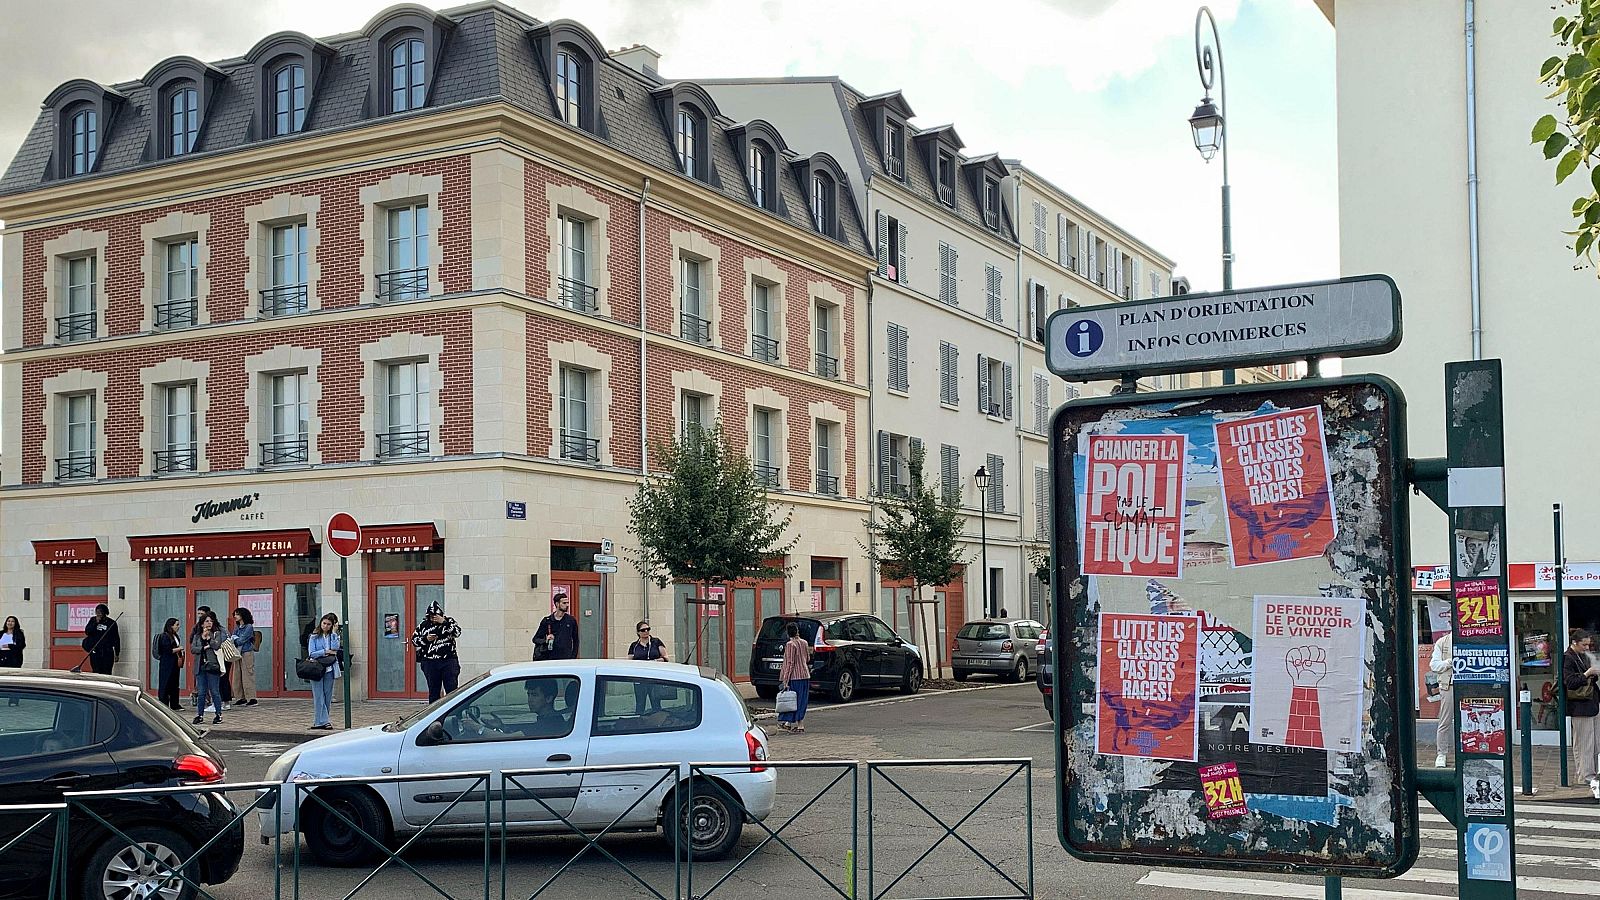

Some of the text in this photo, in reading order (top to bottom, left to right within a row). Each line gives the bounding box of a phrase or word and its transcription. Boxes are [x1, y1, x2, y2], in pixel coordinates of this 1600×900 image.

[1119, 294, 1315, 326] PLAN D'ORIENTATION
[1128, 322, 1306, 351] INFOS COMMERCES
[1229, 415, 1307, 446] LUTTE DES
[1094, 440, 1178, 461] CHANGER LA
[1238, 437, 1304, 466] CLASSES
[1243, 458, 1304, 486] PAS DES
[1091, 462, 1178, 518] POLI
[1249, 479, 1304, 506] RACES!
[1116, 495, 1149, 508] PAS LE
[144, 541, 292, 555] RISTORANTE PIZZERIA
[369, 536, 417, 545] TRATTORIA
[1090, 522, 1175, 573] TIQUE
[1266, 604, 1342, 617] DEFENDRE
[1457, 594, 1500, 624] 32H
[1113, 619, 1185, 642] LUTTE DES
[1266, 615, 1352, 628] LE POUVOIR
[1266, 626, 1331, 638] DE VIVRE
[1117, 640, 1180, 662] CLASSES
[1467, 657, 1477, 666] ET
[1478, 657, 1502, 667] VOUS
[1119, 660, 1176, 681] PAS DES
[1122, 680, 1172, 702] RACES!
[1208, 743, 1250, 751] NOTRE
[1257, 745, 1304, 754] DESTIN
[1203, 777, 1243, 807] 32H
